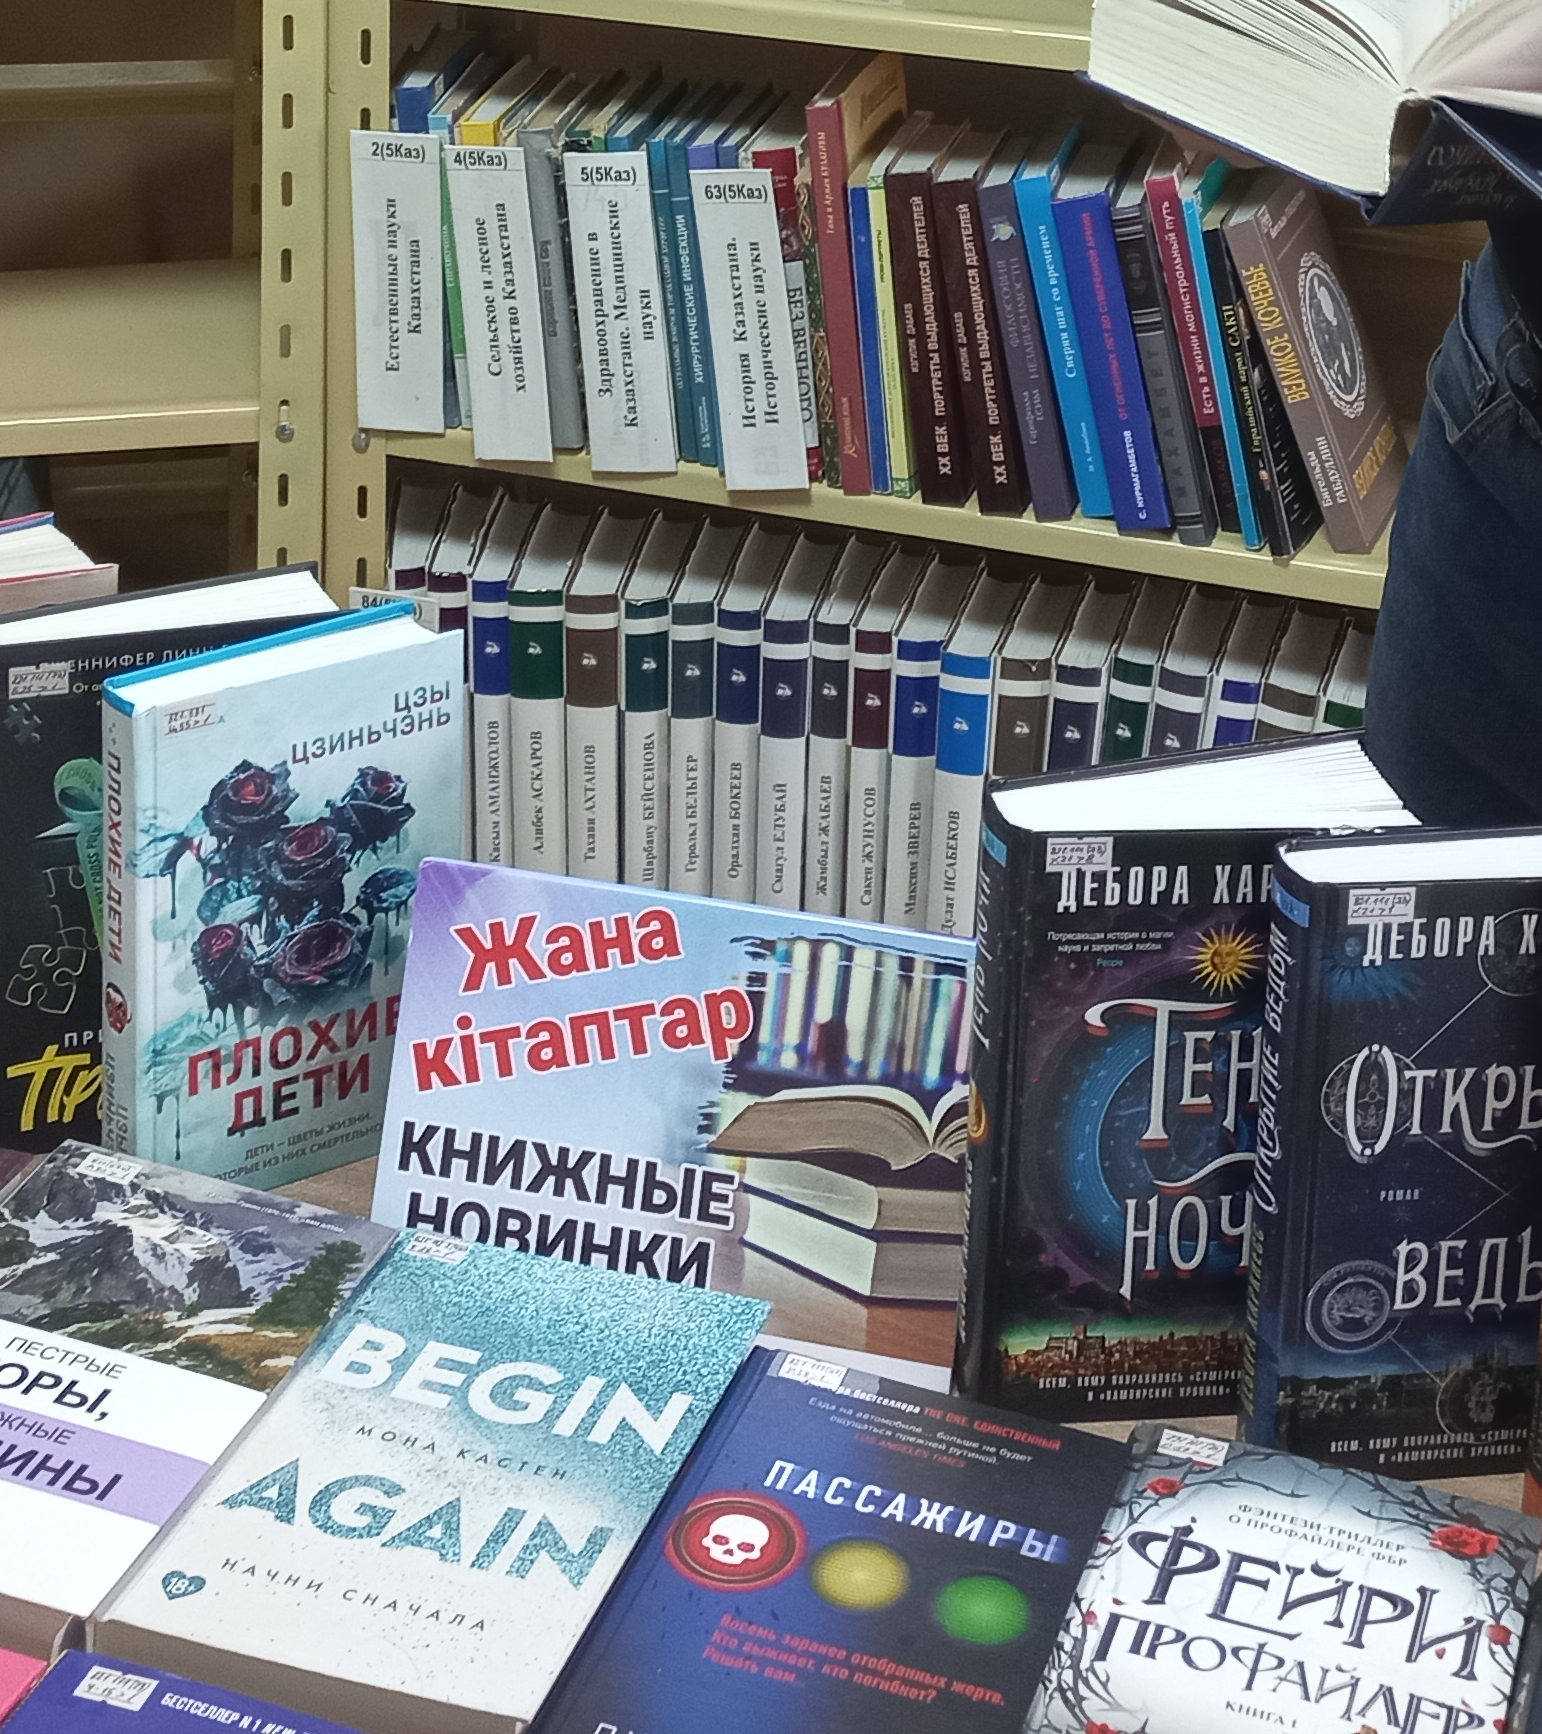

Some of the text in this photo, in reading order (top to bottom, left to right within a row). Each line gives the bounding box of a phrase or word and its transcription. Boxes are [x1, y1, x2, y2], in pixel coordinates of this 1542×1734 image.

[371, 144, 426, 163] 2(5Каз)
[453, 152, 508, 170] 4(5Каз)
[580, 166, 637, 184] 5(5Каз)
[704, 185, 768, 202] 63(5Каз)
[385, 198, 402, 373] Естественные науки
[407, 240, 422, 335] Казахстана
[474, 217, 492, 275] лесное
[486, 298, 503, 377] Сельское
[494, 203, 527, 392] хозяйство Казахстана
[588, 232, 614, 398] Здравоохранение в
[607, 200, 639, 429] Казахстане. Медицинские
[639, 288, 655, 341] науки
[727, 237, 757, 429] История Казахстана.
[749, 240, 780, 425] Исторические науки
[1240, 264, 1311, 404] ВЕЛИКОЕ КОЧЕВЬЕ
[290, 705, 452, 765] ЦЗИНЬЧЭНЬ
[393, 681, 451, 715] ЦЗЫ
[106, 749, 124, 965] ПЛОХИЕ ДЕТИ
[861, 786, 877, 907] Сакен ЖУНУСОВ
[906, 801, 922, 915] Максим ЗВЕРЕВ
[1056, 865, 1191, 913] ДЕБОРА
[453, 906, 684, 996] Жана
[1362, 914, 1499, 967] ДЕБОРА
[410, 985, 755, 1093] кітаптар
[227, 1054, 372, 1138] ДЕТИ
[397, 1119, 744, 1230] КНИЖНЫЕ
[1379, 1188, 1421, 1203] РОМАН
[404, 1190, 714, 1292] НОВИНКИ
[3, 1335, 125, 1381] ПЕСТРЫЕ
[316, 1323, 691, 1457] BEGIN
[355, 1423, 570, 1481] МОНА КАСТЕН
[217, 1457, 615, 1592] AGAIN
[762, 1460, 1059, 1563] ПАССАЖИРЫ
[1237, 1501, 1407, 1552] ФЭНТЕЗИ-ТРИЛЛЕР
[1244, 1515, 1366, 1558] ПРОФАЙЛЕРЕ
[1369, 1551, 1408, 1567] ФБР
[220, 1557, 488, 1635] НАЧНИ СНАЧАЛА
[1126, 1517, 1488, 1681] ФЕЙРИ
[1092, 1612, 1486, 1734] ПРОФАЙЛЕР
[1224, 1700, 1285, 1726] КНИГА
